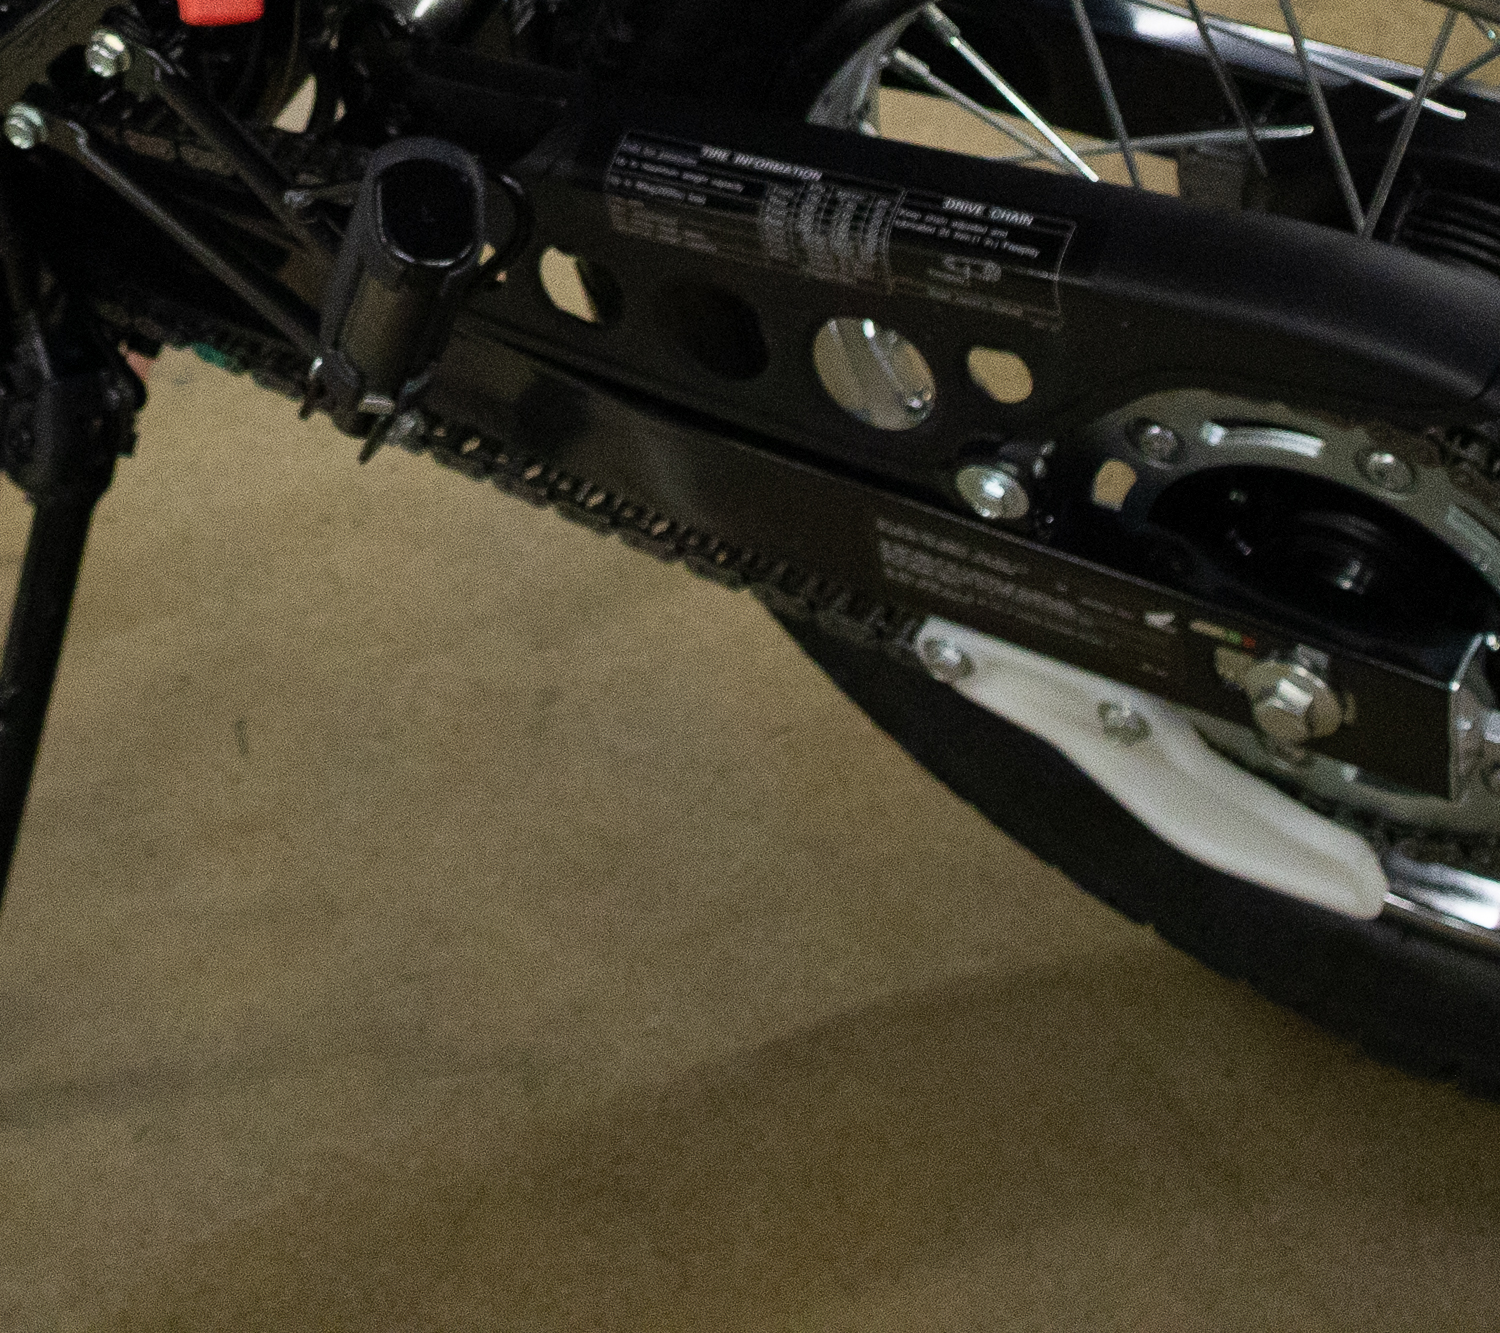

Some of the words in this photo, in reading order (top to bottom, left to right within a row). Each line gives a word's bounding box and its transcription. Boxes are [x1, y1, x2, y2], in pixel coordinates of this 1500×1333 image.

[733, 152, 824, 182] INFORMATION
[942, 196, 987, 217] DRIVE
[988, 206, 1035, 227] CHAIN
